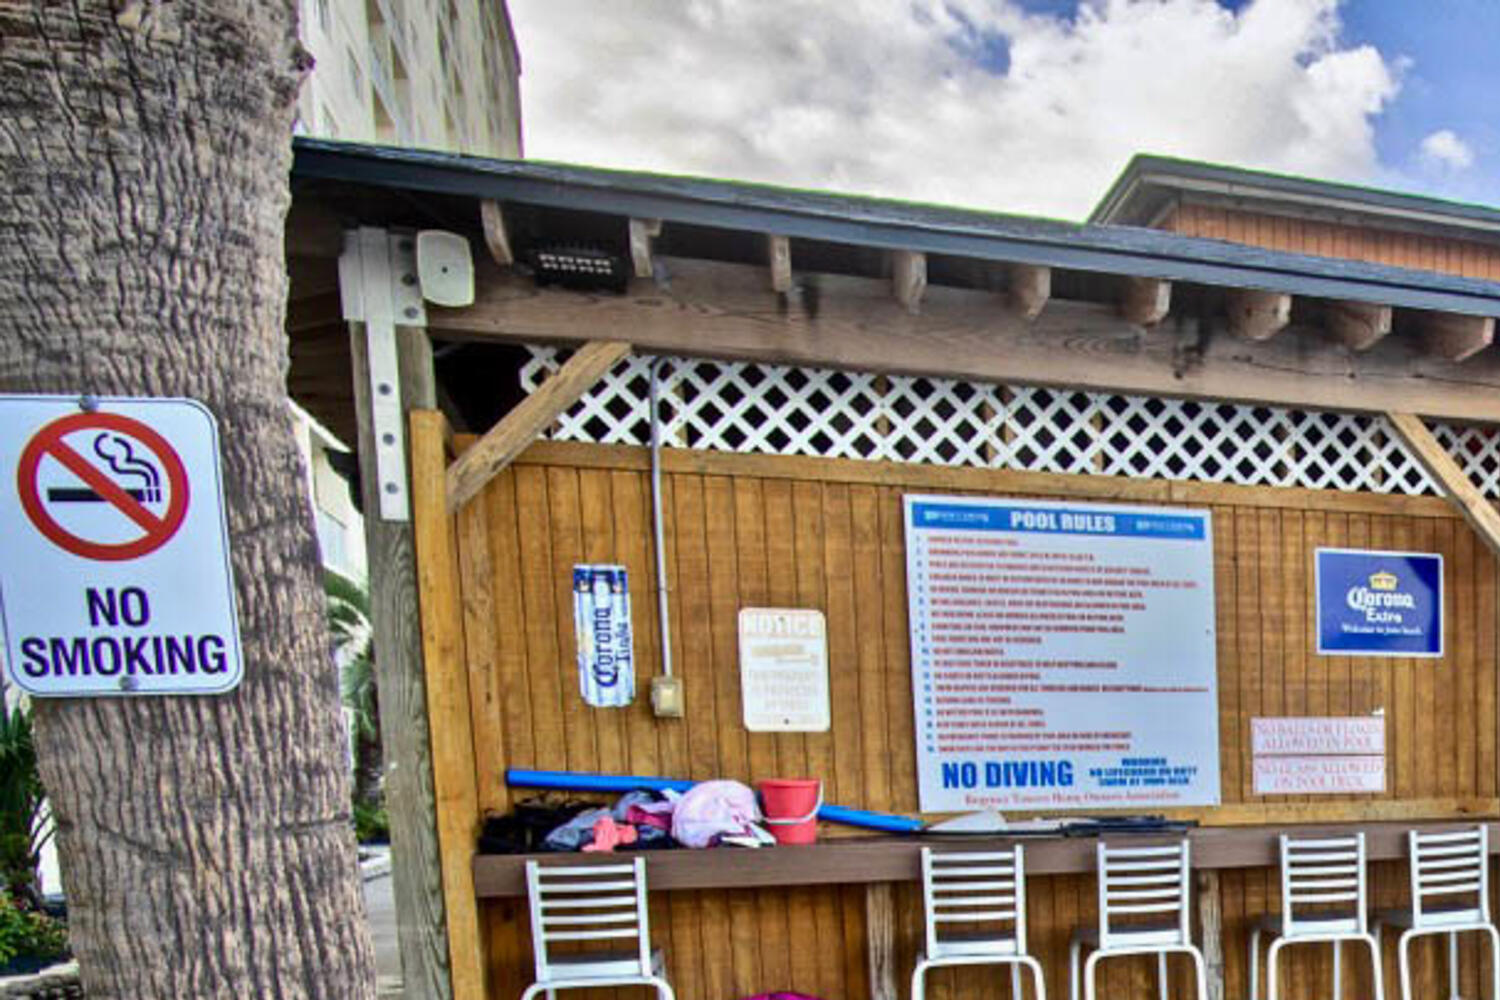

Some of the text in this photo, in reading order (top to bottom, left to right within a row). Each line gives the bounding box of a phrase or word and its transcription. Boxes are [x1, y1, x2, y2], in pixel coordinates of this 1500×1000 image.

[1010, 510, 1058, 531] POOL
[1061, 512, 1117, 534] RULES
[86, 586, 151, 628] NO
[1346, 586, 1416, 610] Corona
[1366, 607, 1402, 623] Extra
[20, 634, 228, 678] SMOKING
[593, 607, 619, 687] Corona
[942, 761, 1074, 788] NO DIVING
